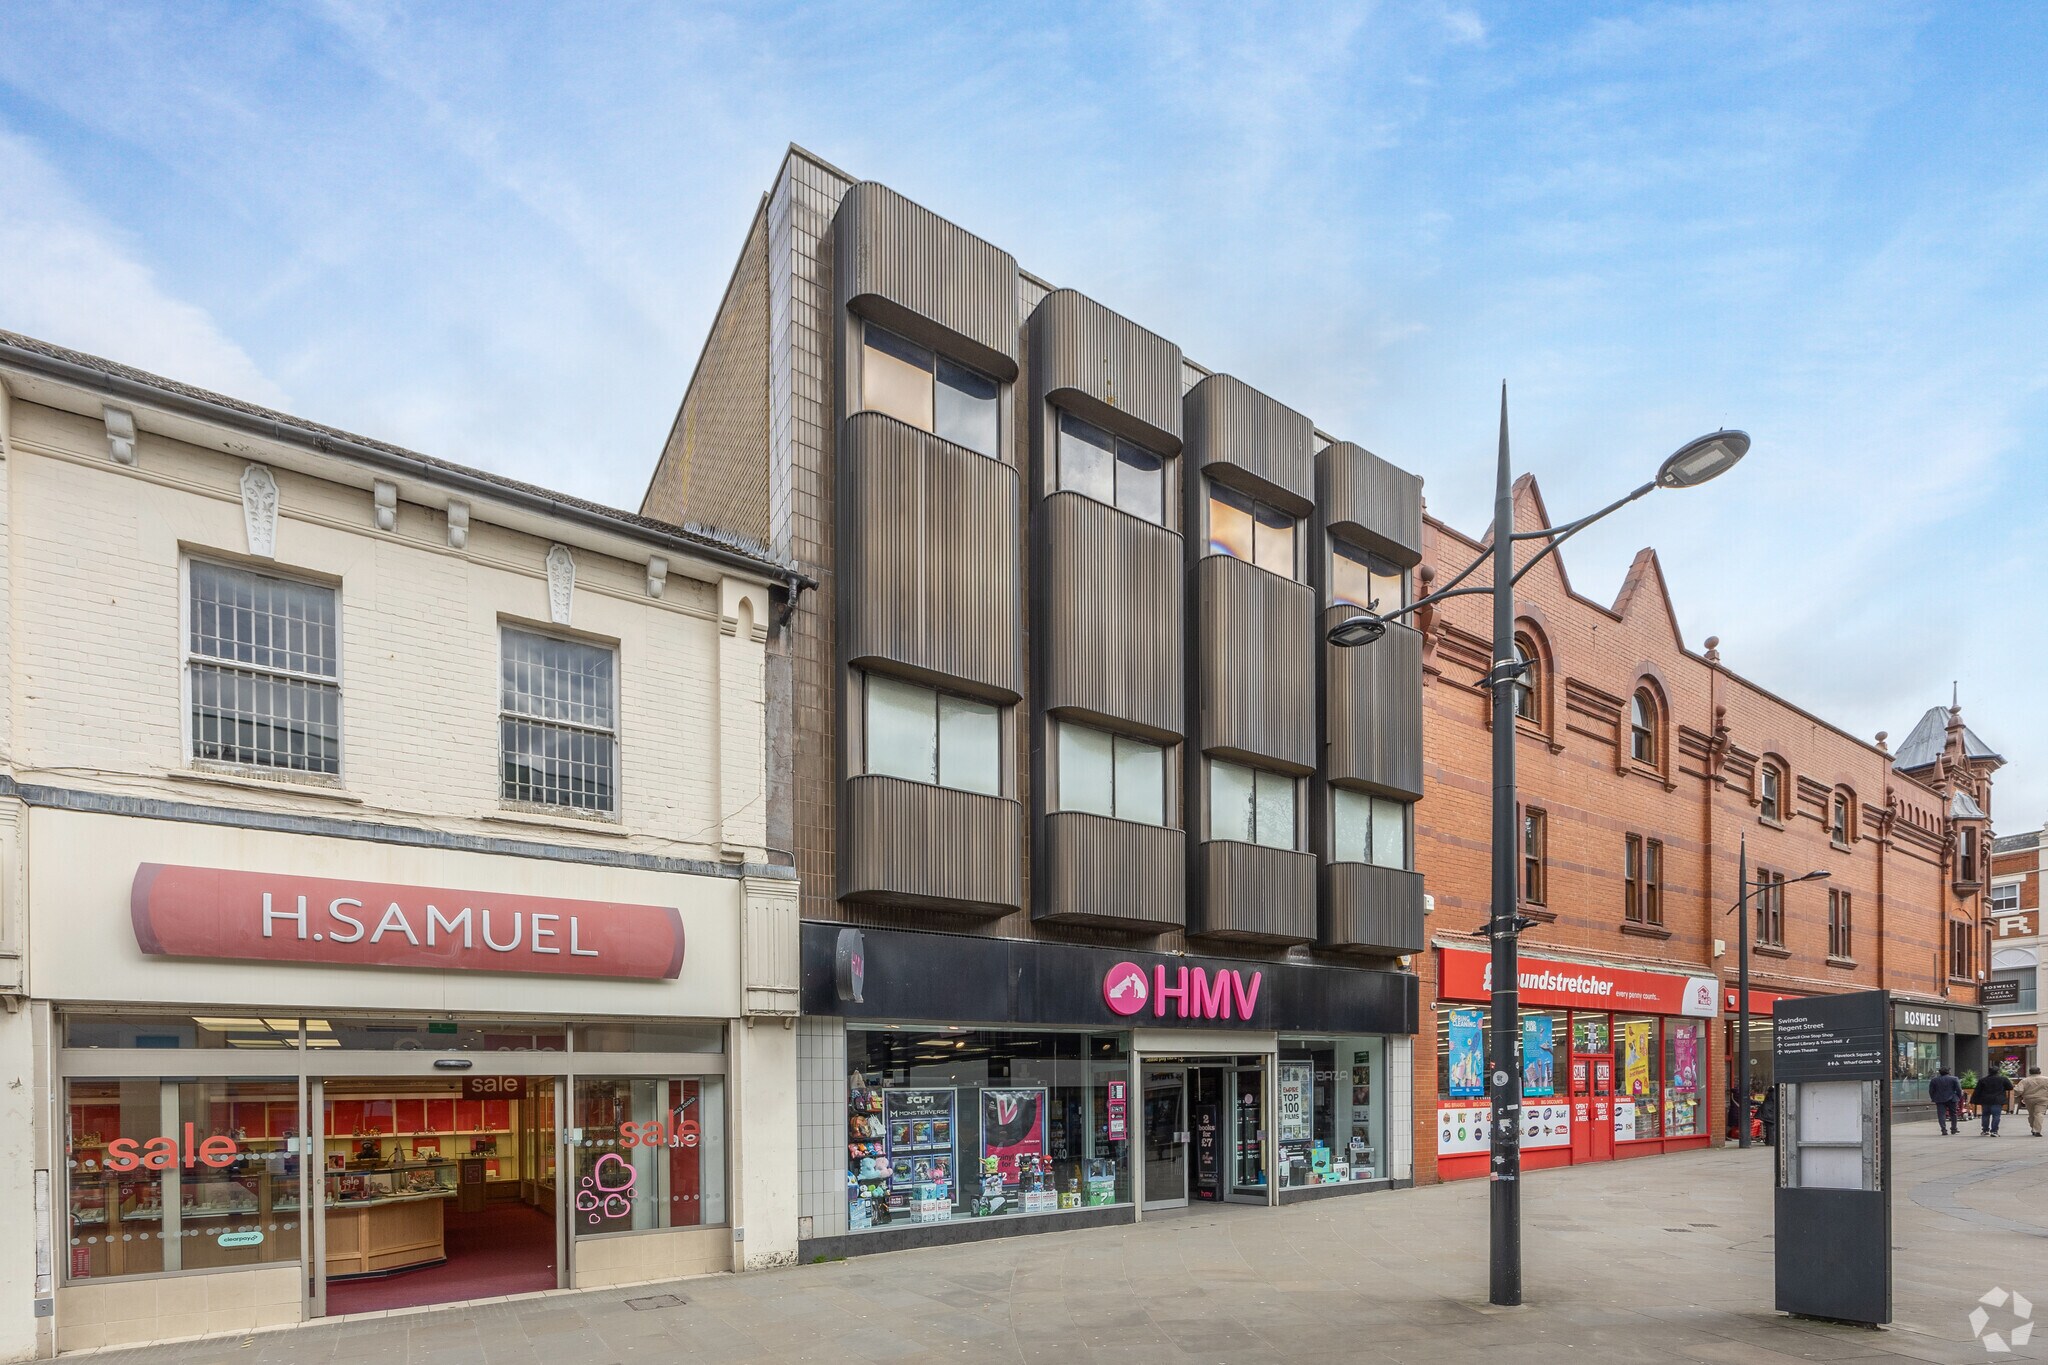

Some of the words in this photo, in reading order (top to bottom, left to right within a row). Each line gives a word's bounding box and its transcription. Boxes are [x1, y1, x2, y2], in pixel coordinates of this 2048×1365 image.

[263, 892, 599, 957] H.SAMUEL
[1154, 964, 1262, 1021] HMV
[1453, 1020, 1476, 1028] CLEANING
[1778, 1016, 1808, 1025] Swindon
[1988, 1030, 2035, 1040] ARBER
[1574, 1066, 1586, 1079] SALE
[1597, 1066, 1609, 1079] SALE
[471, 1076, 518, 1093] sale
[906, 1095, 934, 1104] SCI-FI
[1283, 1093, 1299, 1102] TOP
[1284, 1102, 1300, 1113] 100
[1202, 1114, 1210, 1123] 2
[1555, 1110, 1567, 1119] Surf
[619, 1109, 702, 1148] sale
[108, 1122, 237, 1172] sale
[1201, 1138, 1213, 1147] £7
